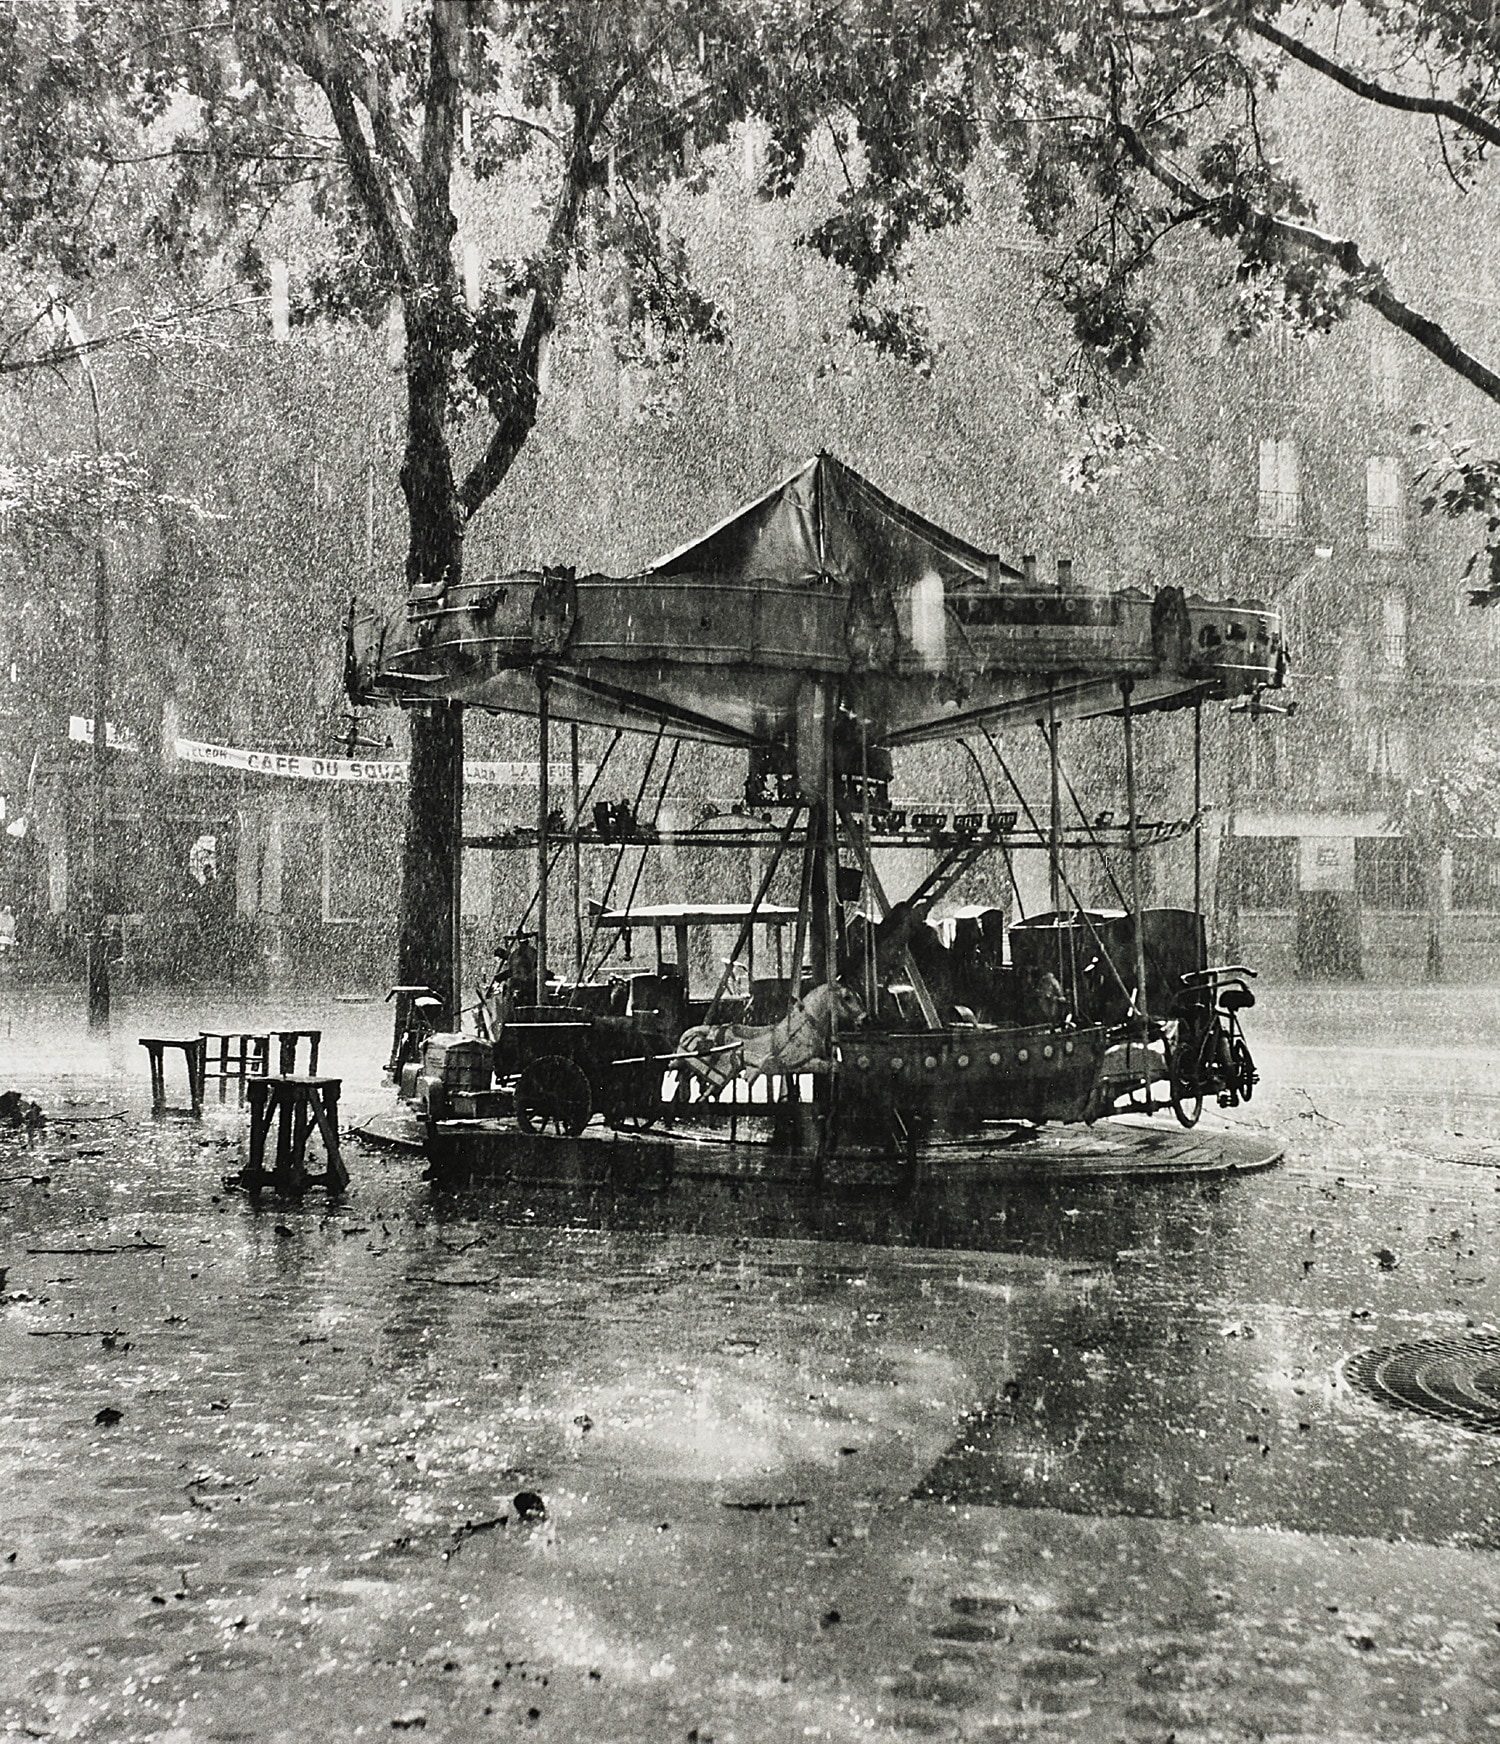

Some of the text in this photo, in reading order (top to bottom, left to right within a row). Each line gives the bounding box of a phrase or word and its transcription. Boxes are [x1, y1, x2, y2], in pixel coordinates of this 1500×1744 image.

[312, 760, 339, 777] DU
[350, 762, 405, 780] SQUA
[465, 766, 496, 781] LARD
